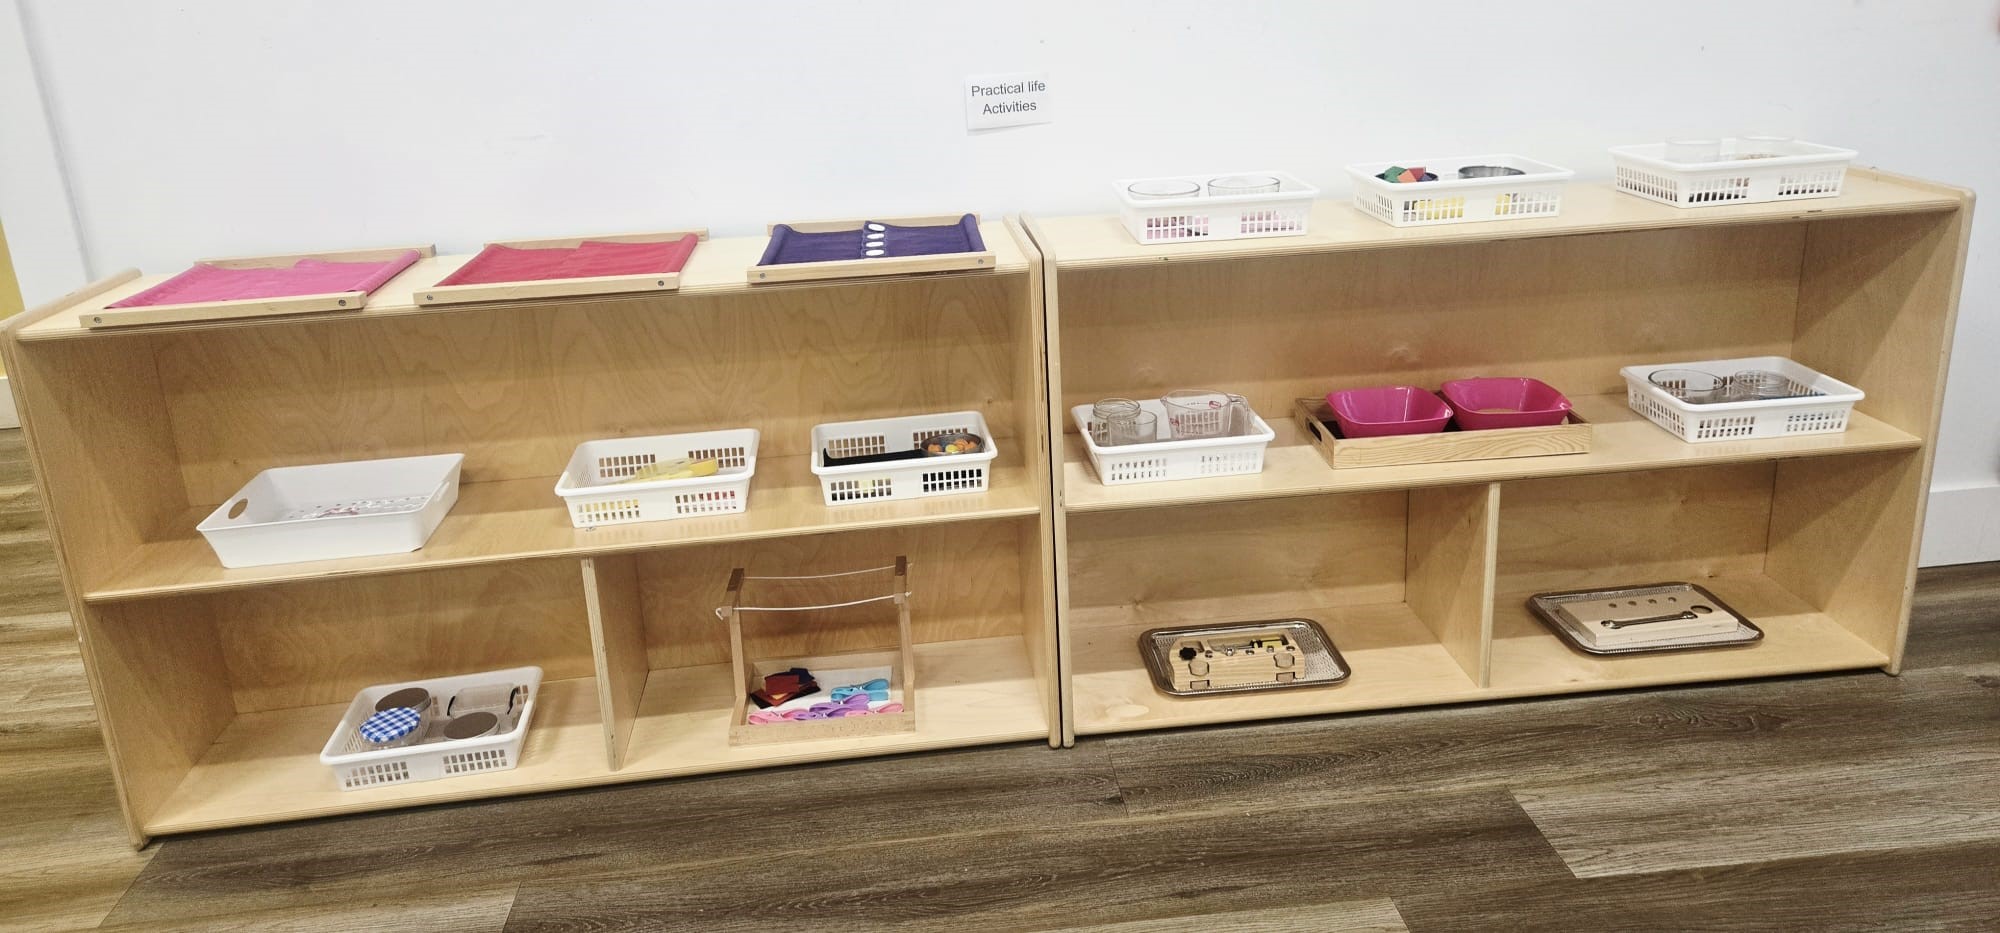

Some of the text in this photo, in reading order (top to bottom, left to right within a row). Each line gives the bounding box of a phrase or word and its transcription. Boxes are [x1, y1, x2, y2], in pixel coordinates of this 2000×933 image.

[971, 80, 1046, 97] Practical life
[983, 100, 1037, 115] Activities
